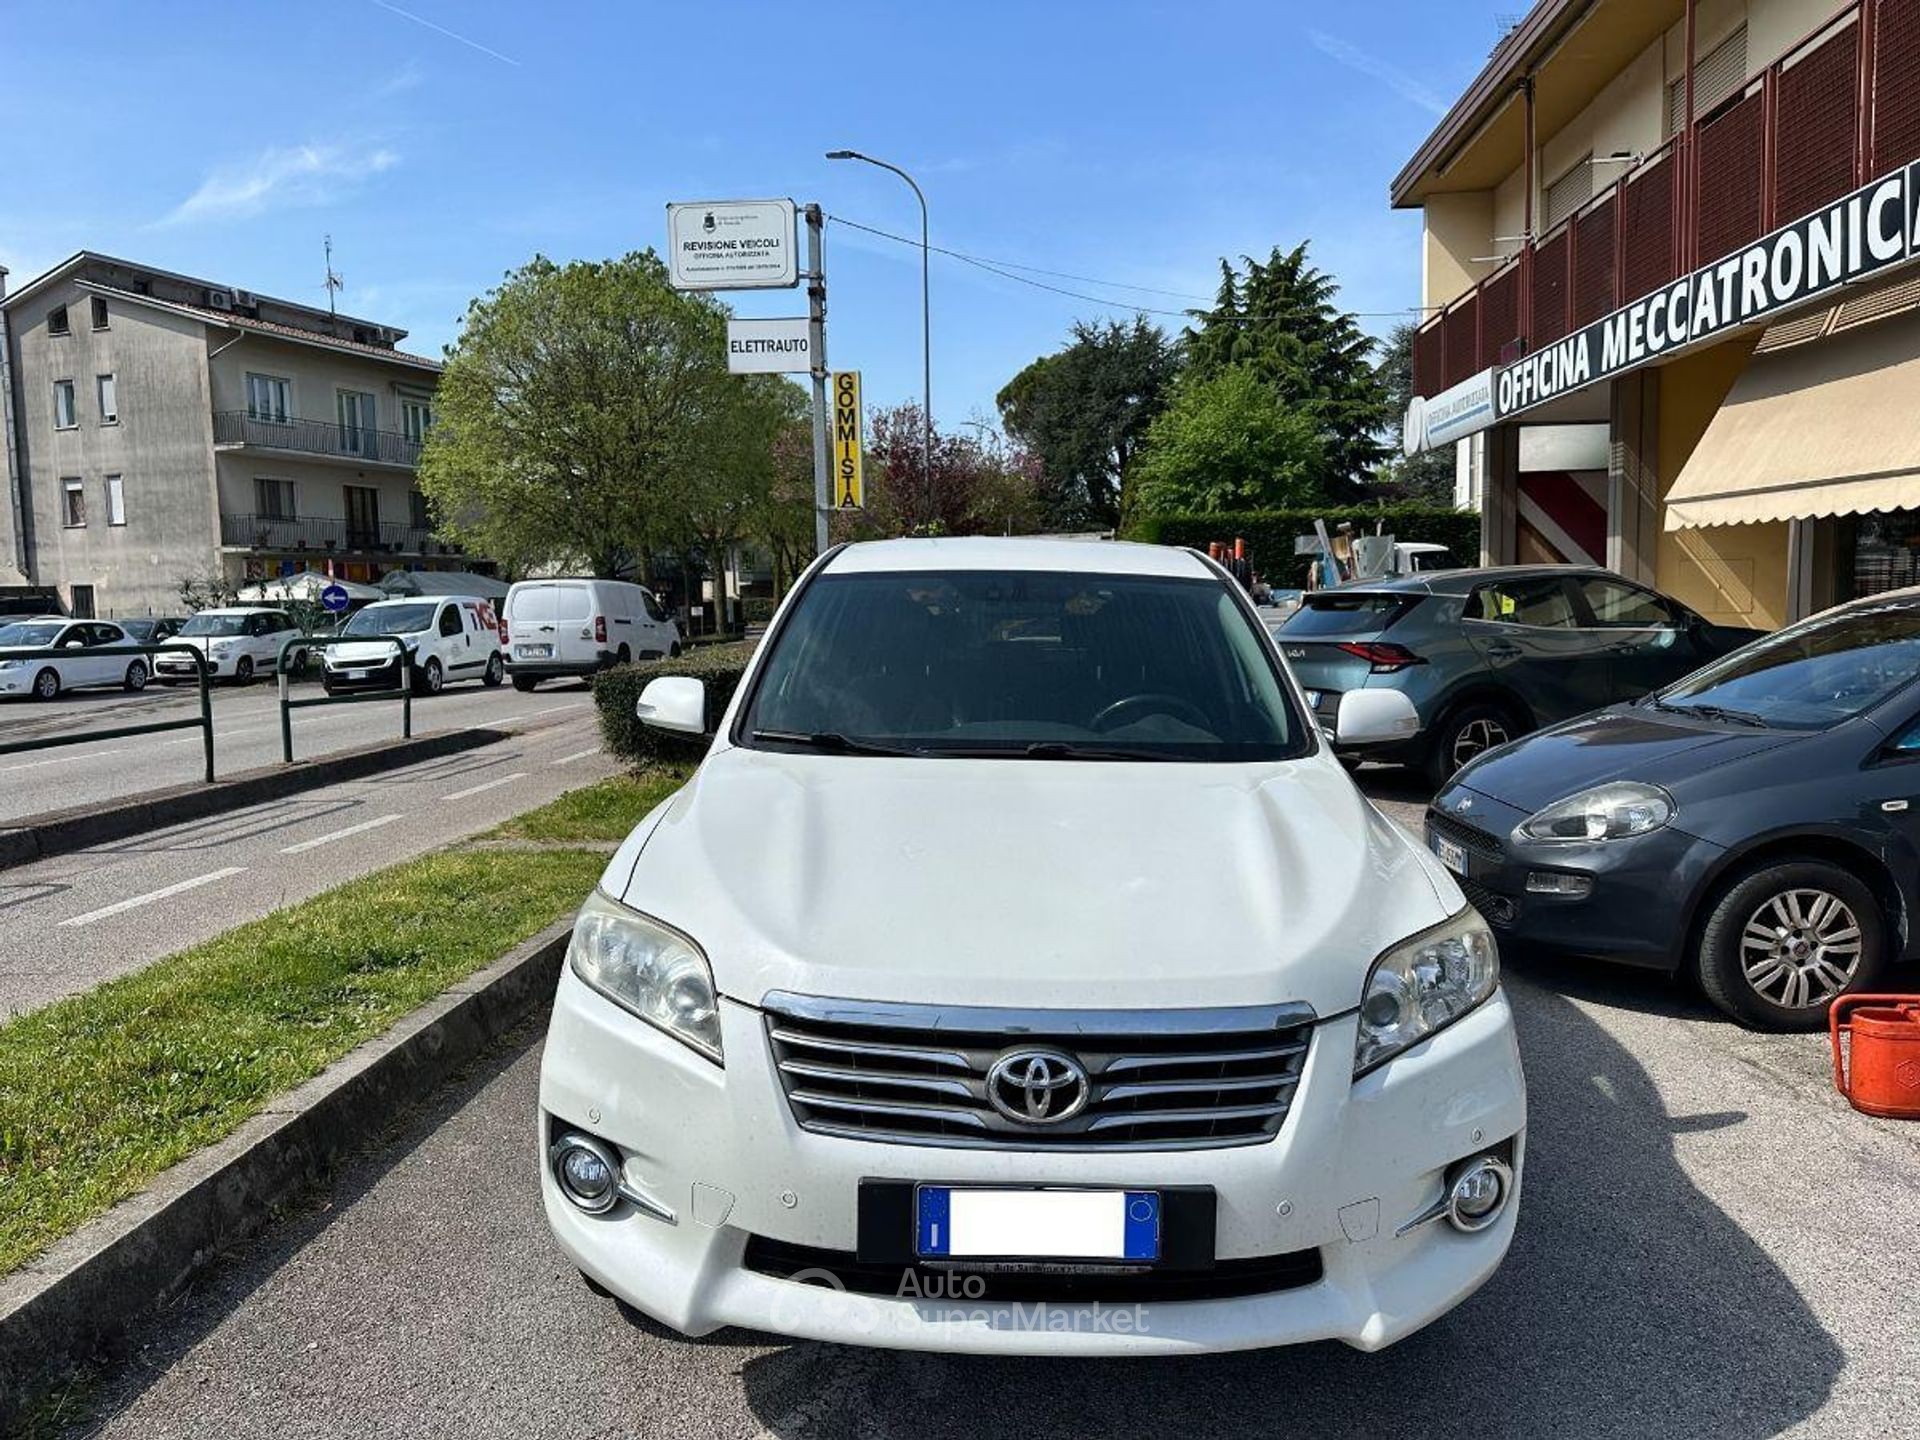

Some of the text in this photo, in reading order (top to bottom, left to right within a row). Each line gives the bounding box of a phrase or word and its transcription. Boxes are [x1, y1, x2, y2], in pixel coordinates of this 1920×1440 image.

[683, 238, 780, 251] REVISIONE VEICOLI
[693, 252, 723, 260] OFFICINA
[1499, 178, 1920, 414] OFFICINA MECCATRONIC
[730, 339, 808, 353] ELETTRAUTO
[837, 373, 857, 508] GOMMISTA
